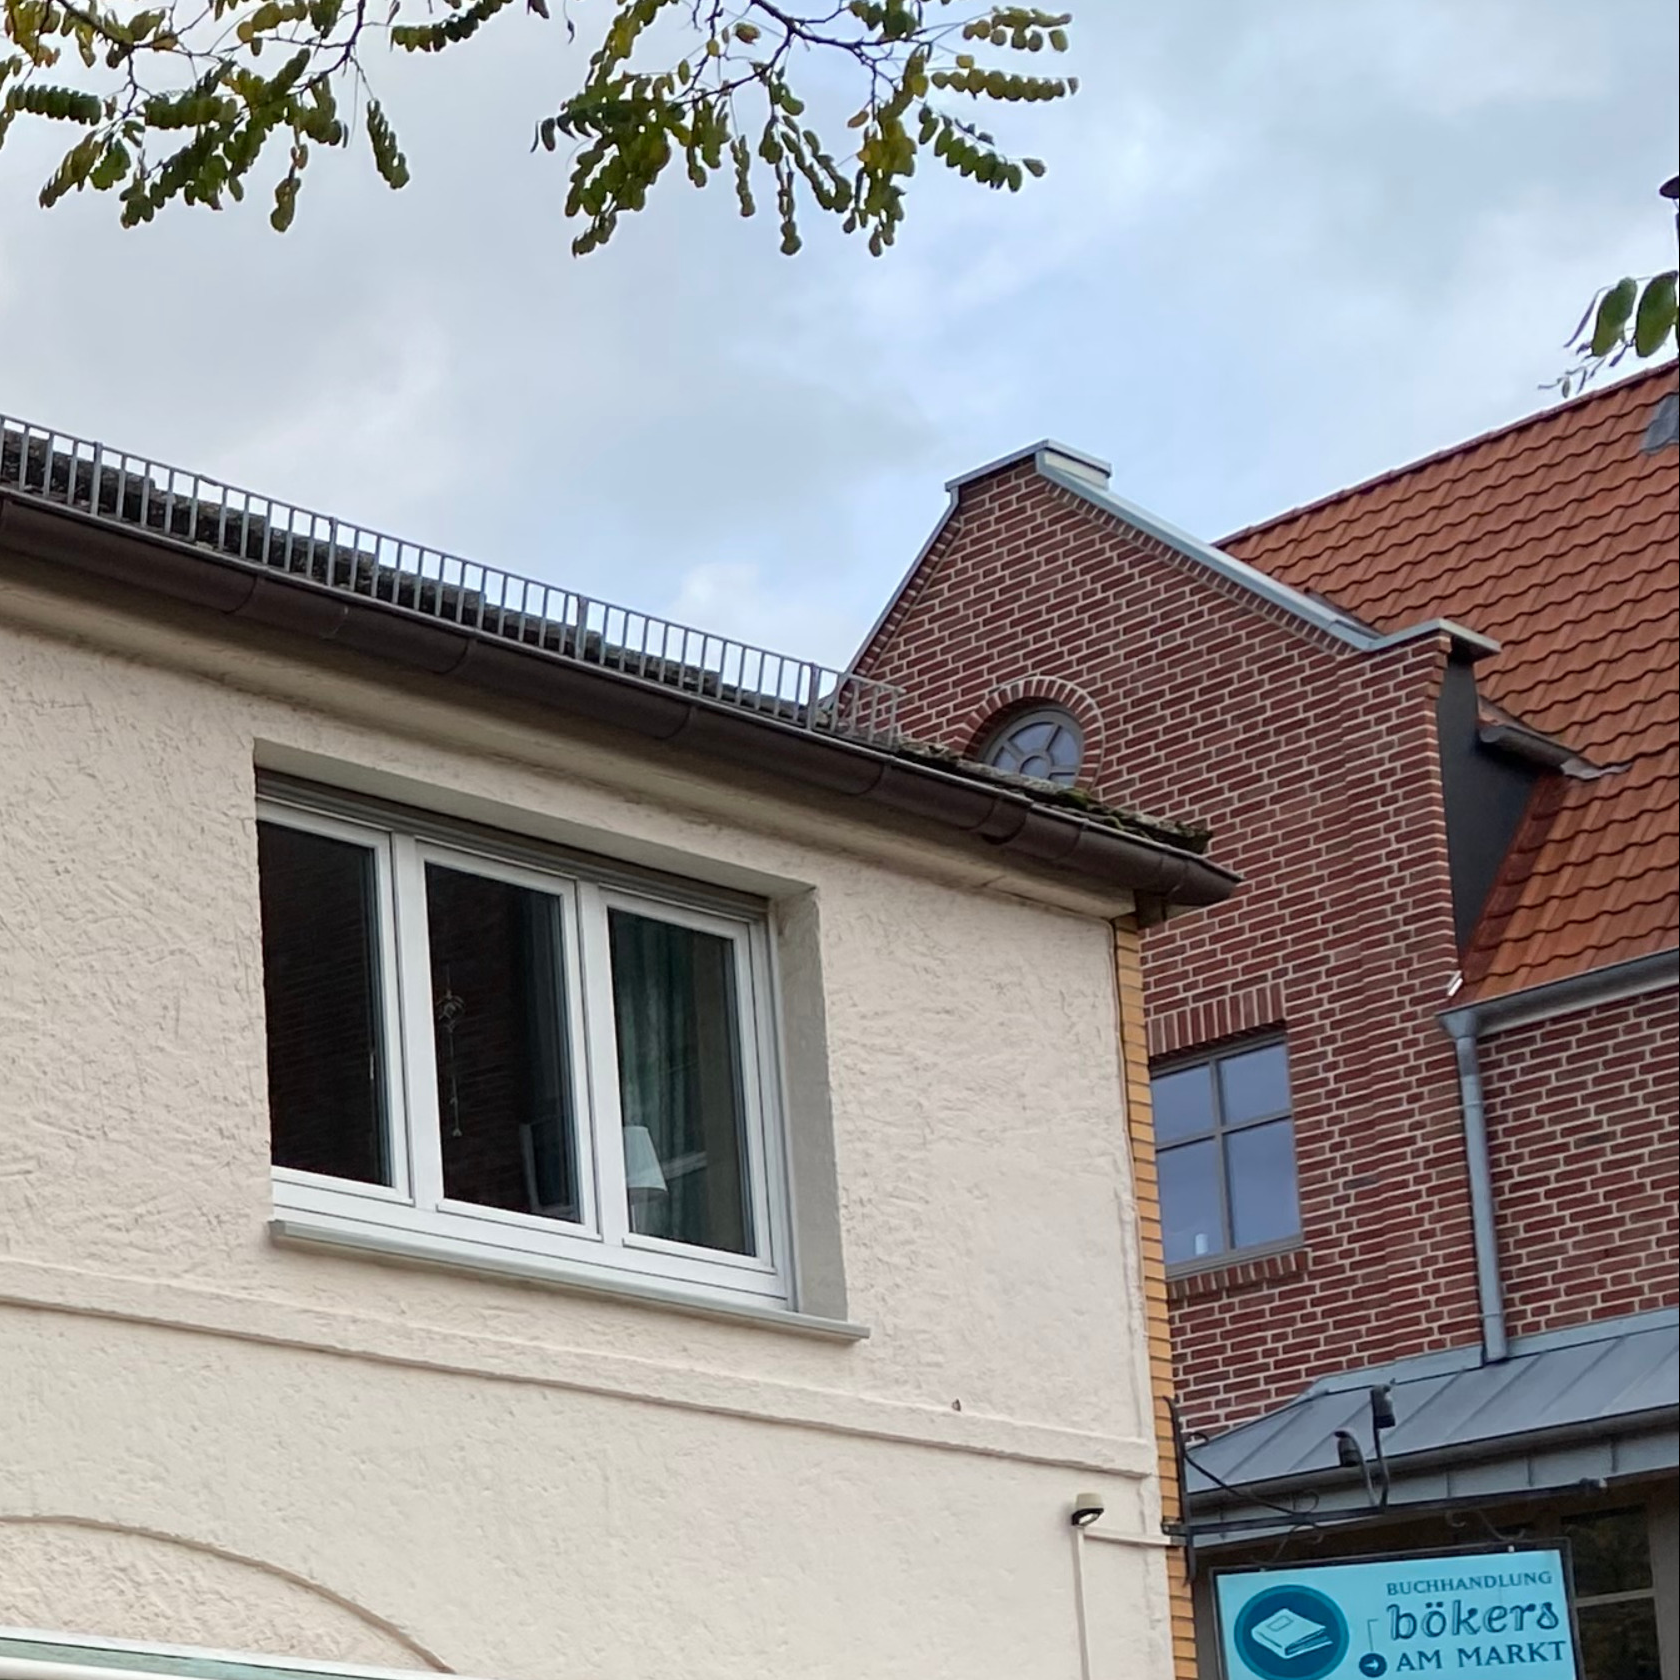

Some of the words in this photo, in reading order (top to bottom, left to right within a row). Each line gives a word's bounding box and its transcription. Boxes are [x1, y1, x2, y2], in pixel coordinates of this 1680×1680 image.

[1386, 1570, 1553, 1597] BUCHHANDLUNG
[1386, 1600, 1560, 1641] bökers
[1395, 1648, 1442, 1673] AM
[1457, 1640, 1567, 1668] MARKT
